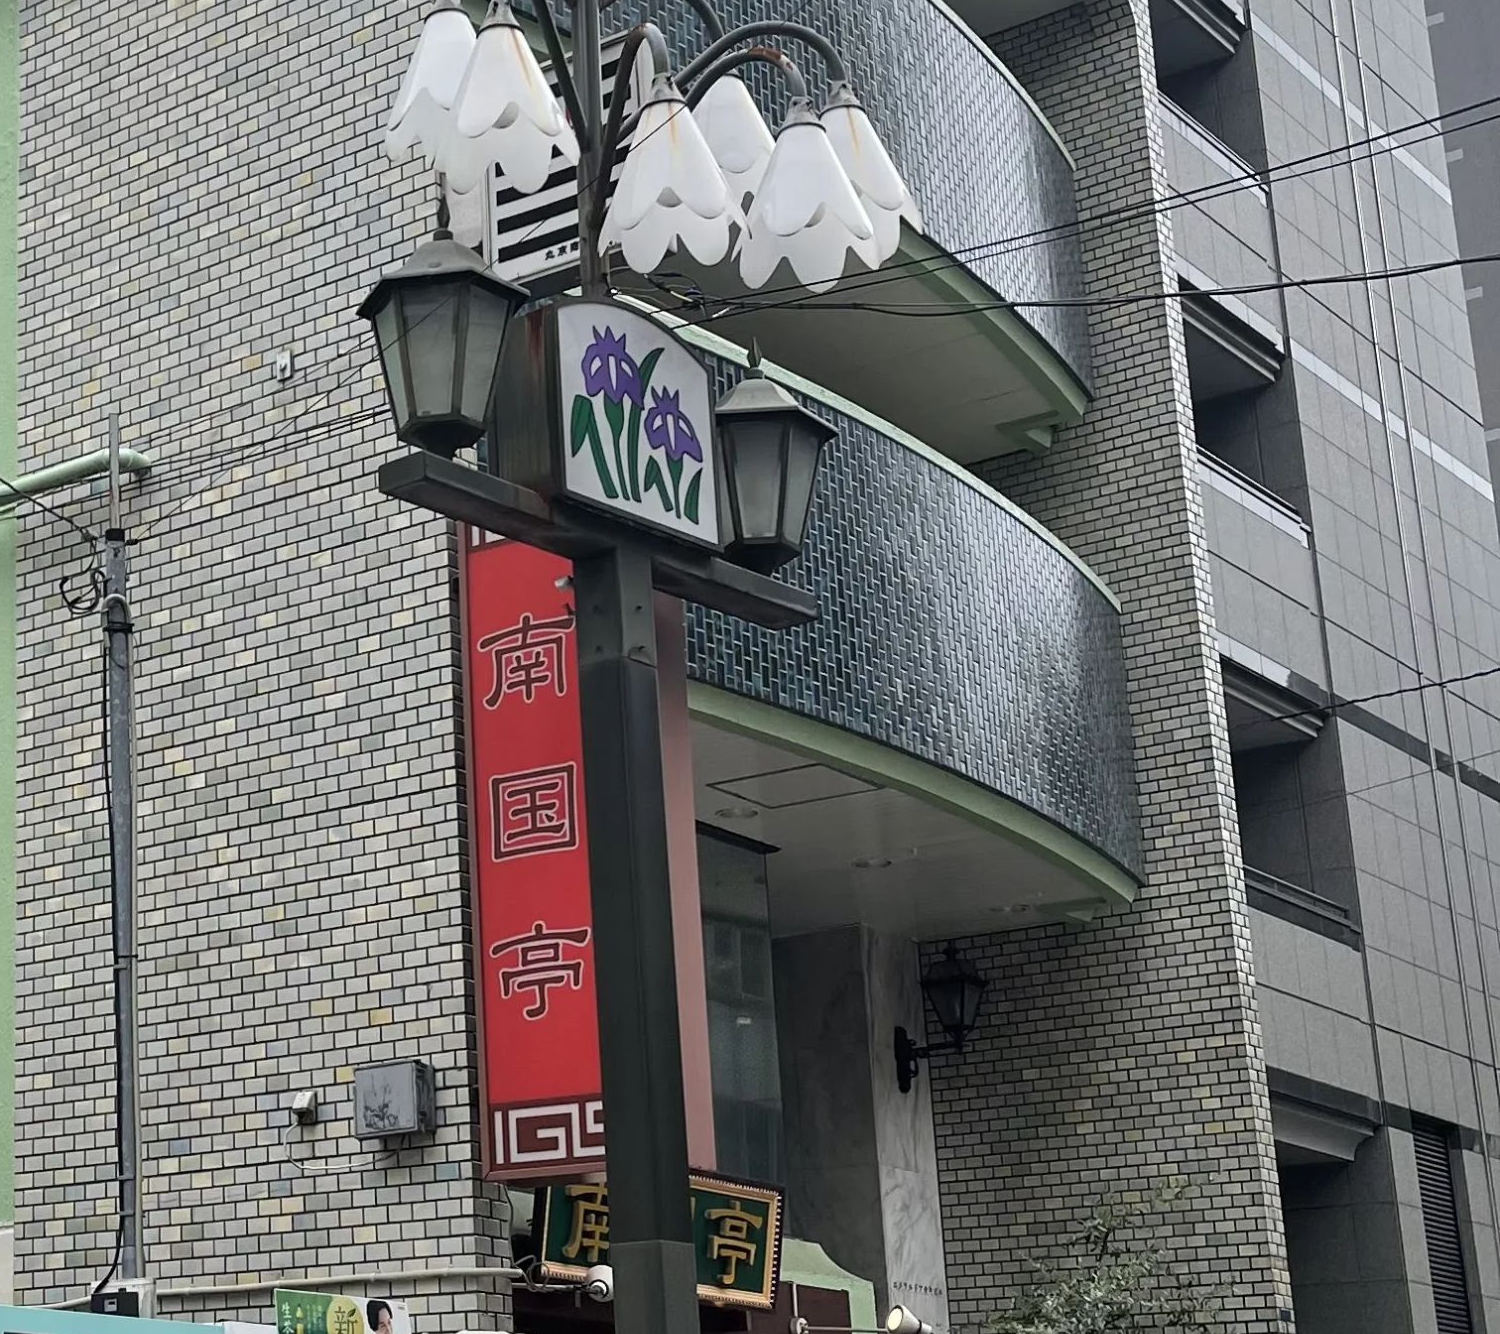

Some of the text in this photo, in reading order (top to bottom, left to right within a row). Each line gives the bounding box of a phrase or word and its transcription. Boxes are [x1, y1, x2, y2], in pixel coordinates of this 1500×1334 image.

[477, 613, 591, 1021] 南国亭
[562, 1177, 763, 1285] 南亭
